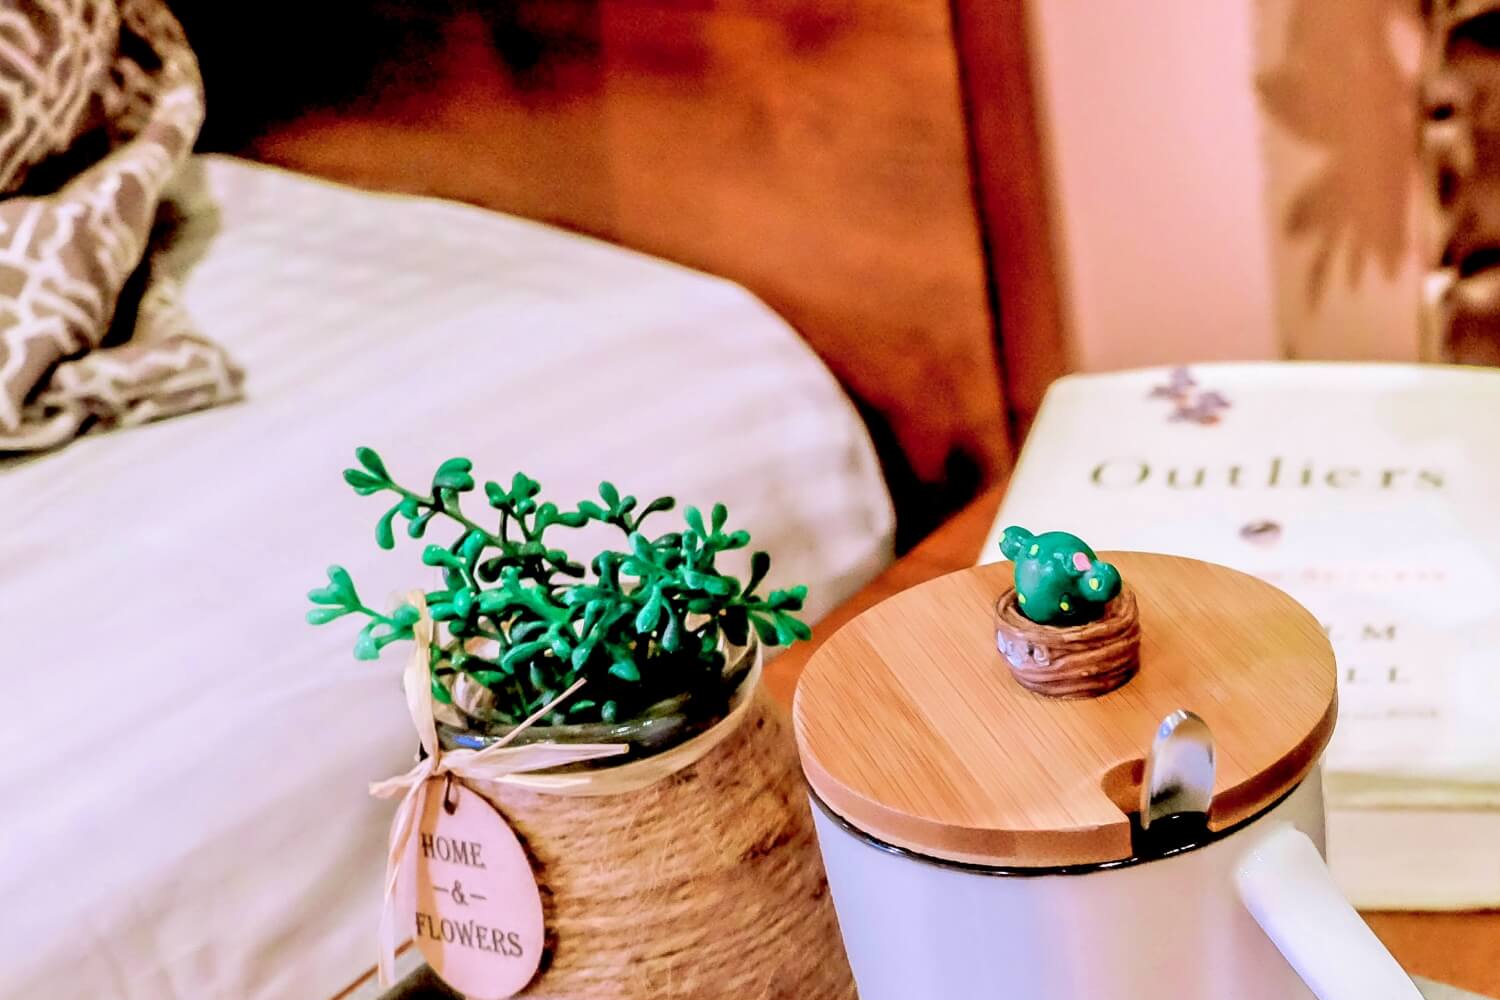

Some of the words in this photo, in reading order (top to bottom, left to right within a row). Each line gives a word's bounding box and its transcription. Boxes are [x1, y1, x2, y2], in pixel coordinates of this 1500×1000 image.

[1088, 454, 1447, 491] Outliers
[421, 832, 486, 869] HOME
[415, 912, 524, 957] FLOWERS
